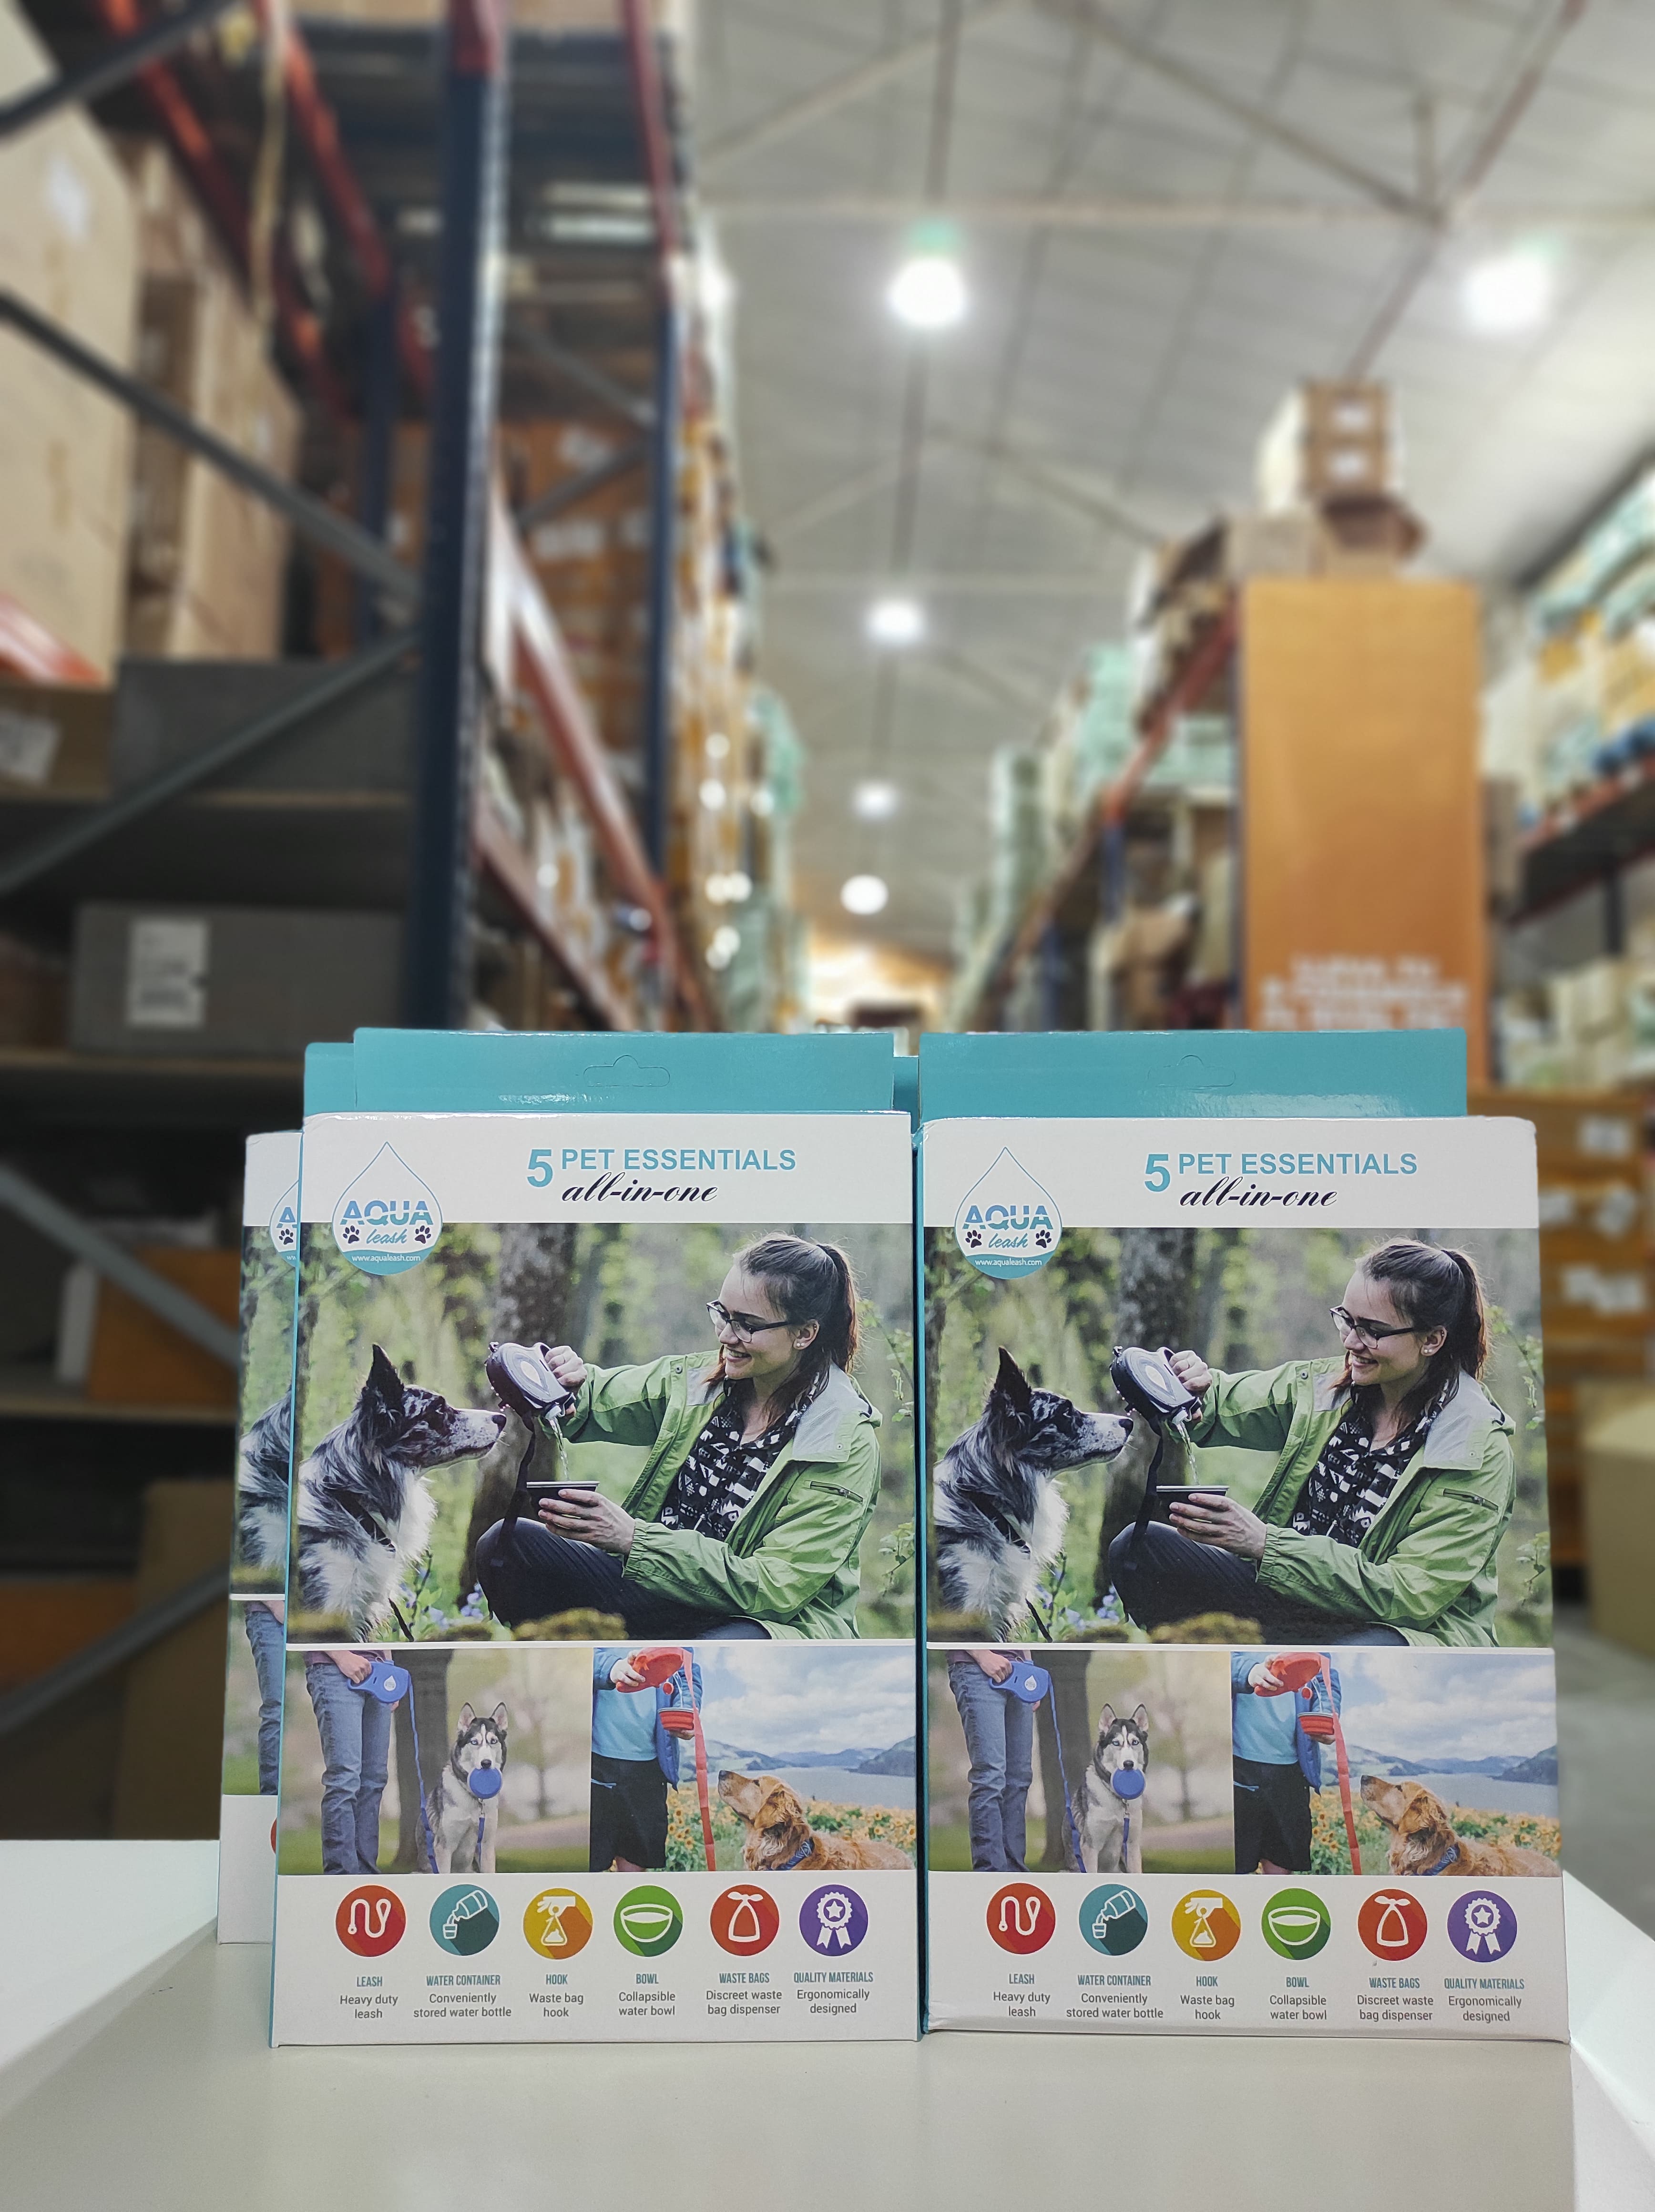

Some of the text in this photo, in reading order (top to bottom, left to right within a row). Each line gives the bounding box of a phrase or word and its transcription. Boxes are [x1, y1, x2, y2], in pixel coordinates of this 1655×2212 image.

[527, 1149, 796, 1187] 5 PET ESSENTIALS
[1144, 1154, 1417, 1191] 5 PET ESSENTIALS
[562, 1172, 717, 1201] all-in-one
[1180, 1177, 1337, 1206] all-in-one
[340, 1200, 433, 1225] AQUA
[962, 1205, 1053, 1229] AQUA
[367, 1228, 407, 1245] leash
[989, 1233, 1028, 1249] leash
[352, 1254, 419, 1262] www.aqualeash.com
[976, 1258, 1041, 1267] www.aqualeash.com
[357, 1976, 382, 1987] LEASH
[427, 1975, 500, 1986] WATER CONTAINER
[546, 1974, 567, 1985] HOOK
[636, 1974, 659, 1984] BOWL
[719, 1973, 769, 1983] WASTE BAGS
[794, 1972, 873, 1983] QUALITY MATERIALS
[1009, 1974, 1034, 1984] LEASH
[1078, 1975, 1151, 1986] WATER CONTAINER
[1196, 1976, 1217, 1987] HOOK
[1286, 1977, 1309, 1987] BOWL
[1369, 1977, 1420, 1988] WASTE BAGS
[1444, 1978, 1524, 1989] QUALITY MATERIALS
[340, 1994, 398, 2007] Heavy duty
[429, 1993, 496, 2005] Conveniently
[529, 1993, 583, 2005] Waste bag
[619, 1991, 675, 2004] Collapsible
[706, 1990, 782, 2000] Discreet waste
[797, 1989, 869, 2001] Ergonomically
[993, 1991, 1050, 2004] Heavy duty
[1081, 1993, 1147, 2006] Conveniently
[1358, 1995, 1433, 2006] Discreet waste
[1180, 1995, 1234, 2007] Waste bag
[1269, 1995, 1326, 2007] Collapsible
[1449, 1996, 1522, 2008] Ergonomically
[355, 2008, 382, 2018] leash
[413, 2007, 511, 2017] stored water bottle
[543, 2007, 569, 2017] hook
[619, 2006, 675, 2016] water bowl
[707, 2004, 780, 2017] bag dispenser
[810, 2003, 856, 2016] designed
[1009, 2007, 1035, 2017] leash
[1066, 2007, 1163, 2018] stored water bottle
[1195, 2009, 1220, 2019] hook
[1270, 2009, 1327, 2020] water bowl
[1359, 2010, 1432, 2023] bag dispenser
[1463, 2011, 1510, 2023] designed
